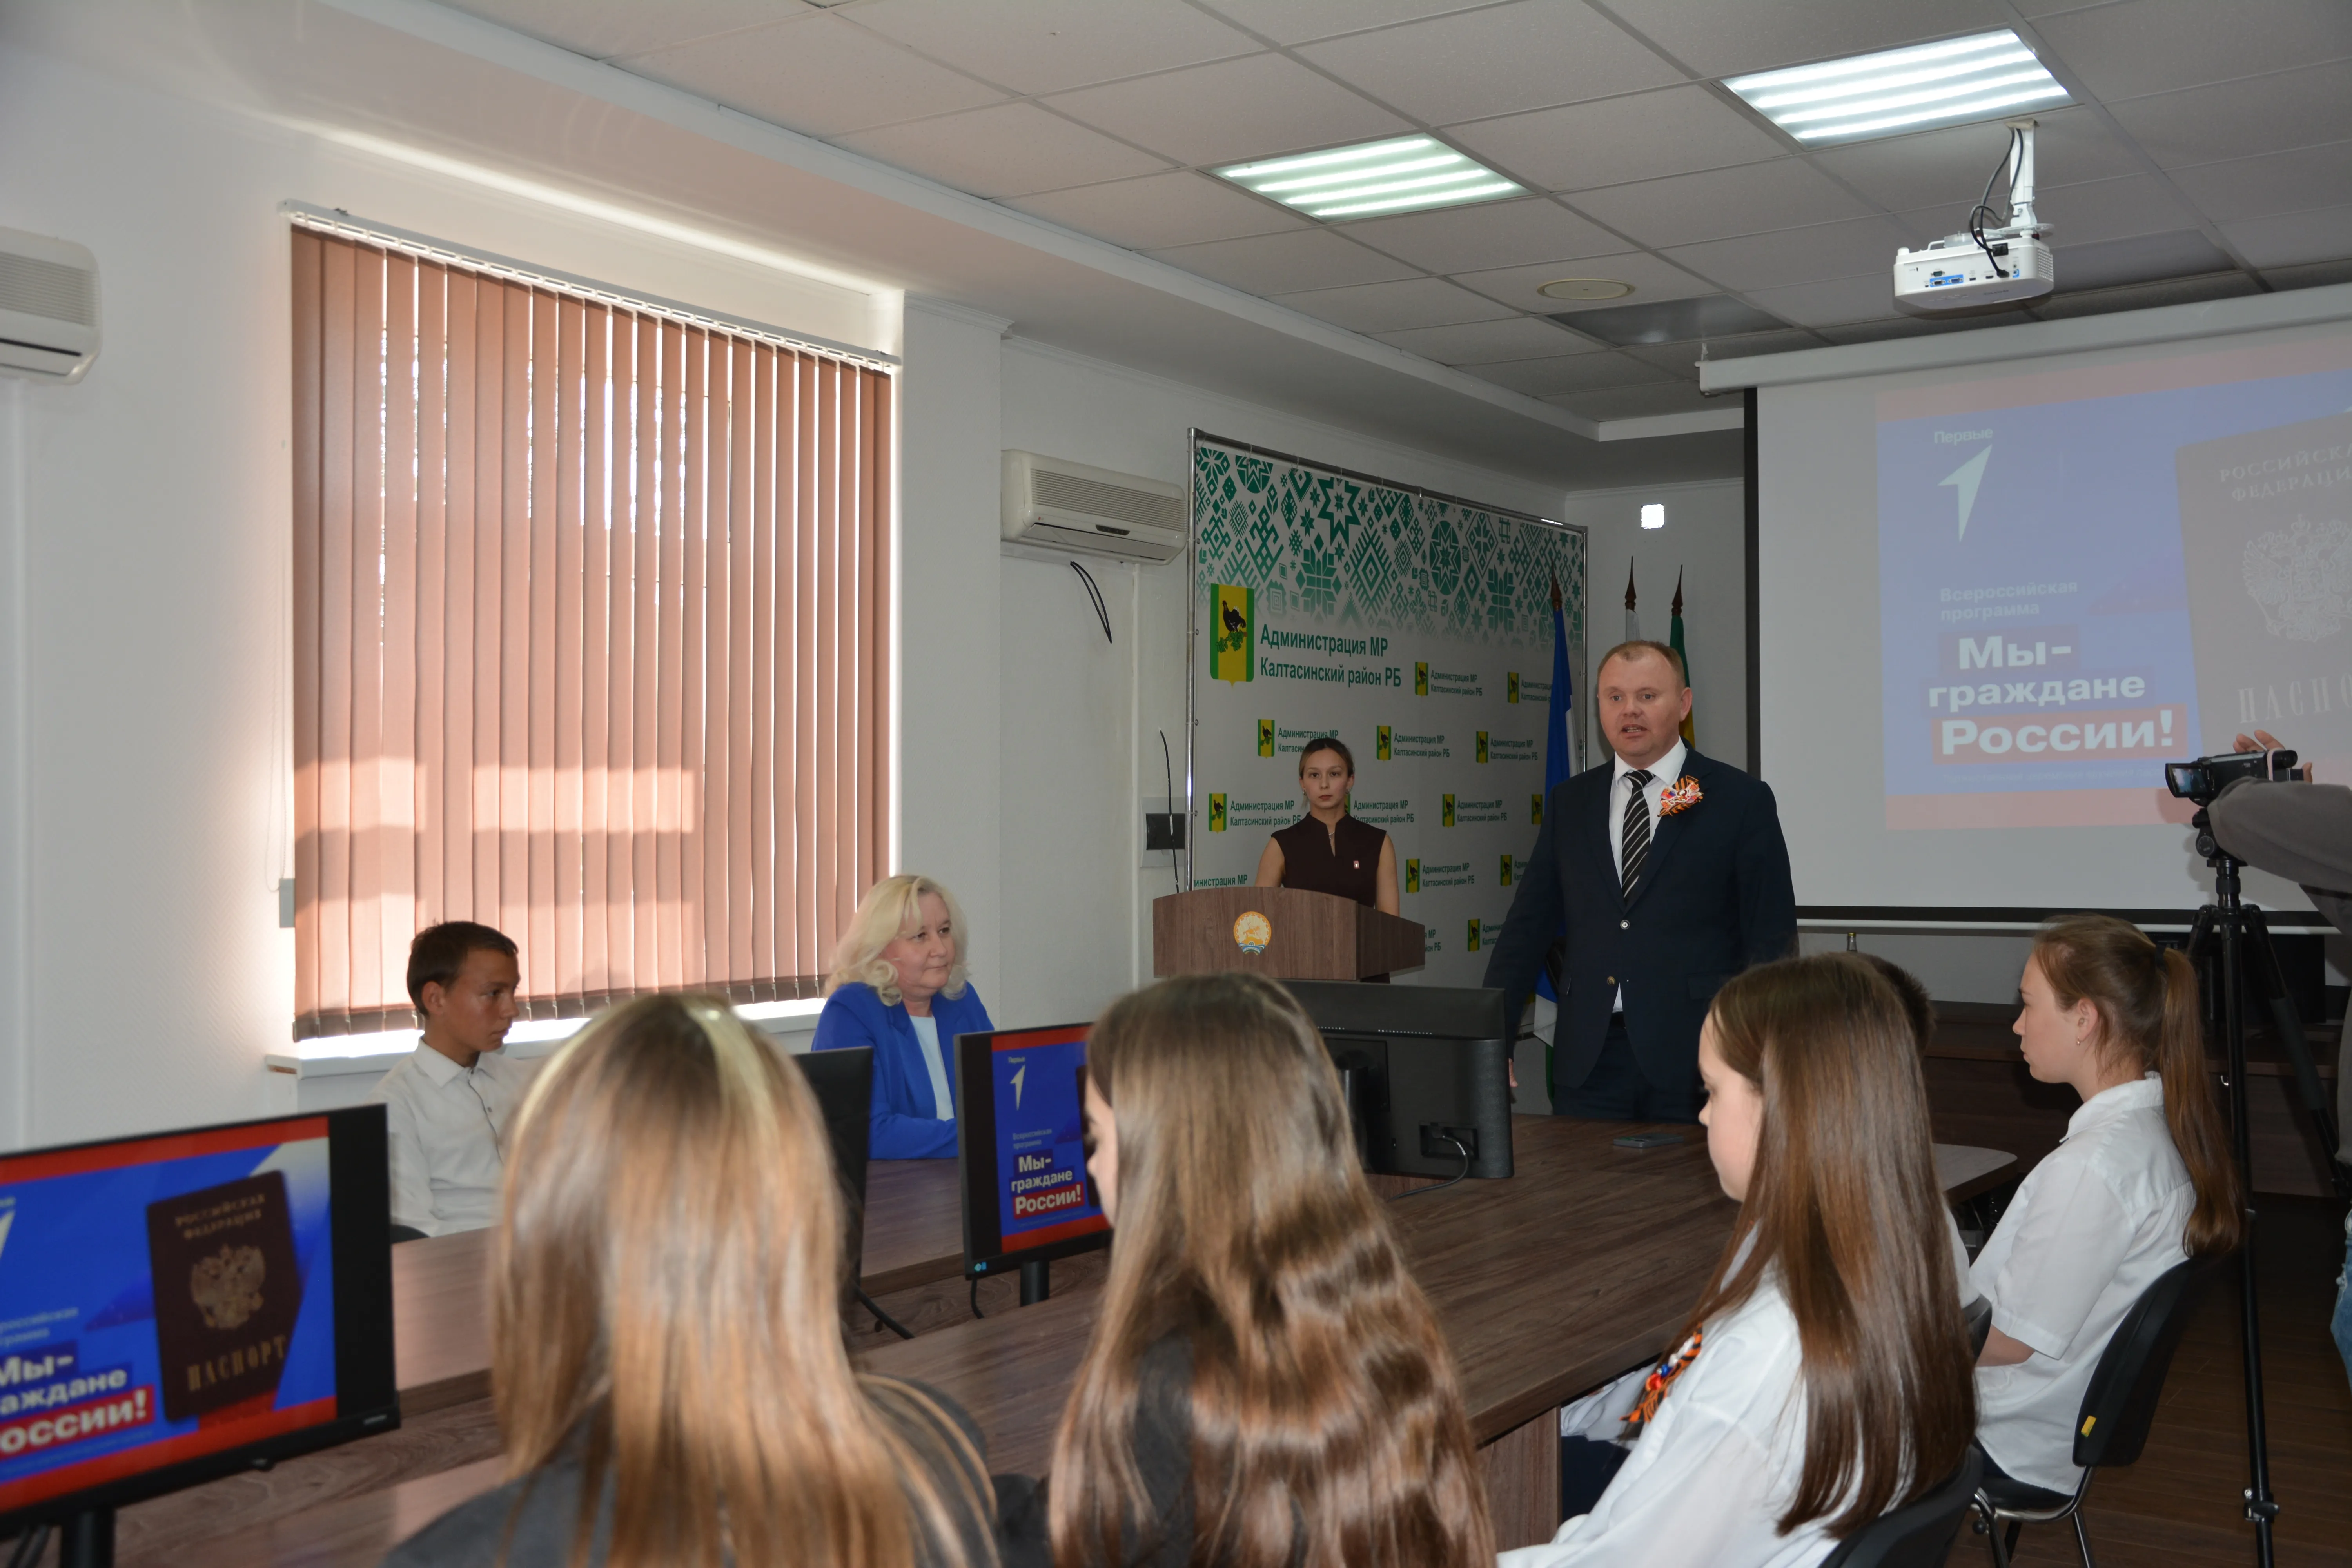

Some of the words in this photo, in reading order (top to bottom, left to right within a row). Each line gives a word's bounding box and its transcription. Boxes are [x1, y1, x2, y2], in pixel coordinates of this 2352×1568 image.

[1934, 428, 1993, 446] Первые
[1940, 581, 2078, 603] Всероссийская
[1940, 603, 2040, 624] программа
[1260, 624, 1366, 657] Администрация
[1370, 636, 1388, 657] МР
[1958, 635, 2072, 670] Мы-
[1261, 657, 1345, 683] Калтасинский
[1348, 666, 1381, 687] район
[1385, 667, 1401, 687] РБ
[1431, 670, 1469, 683] Администрация
[1470, 674, 1477, 682] МР
[1431, 684, 1461, 694] Калтасинский
[1461, 687, 1475, 697] район
[1476, 688, 1483, 696] РБ
[1928, 675, 2145, 713] граждане
[1278, 728, 1328, 740] Администрация
[1330, 730, 1339, 739] МР
[1941, 710, 2173, 755] России!
[1394, 733, 1436, 745] Администрация
[1437, 735, 1445, 744] МР
[1490, 738, 1526, 748] Администрация
[1278, 743, 1305, 753] Калтасин
[1394, 748, 1427, 757] Калтасинский
[1428, 749, 1442, 759] район
[1443, 749, 1450, 758] РБ
[1490, 751, 1518, 760] Калтасинский
[1519, 752, 1531, 761] район
[1532, 752, 1538, 760] РБ
[1230, 800, 1283, 813] Администрация
[1285, 800, 1294, 810] МР
[1354, 800, 1399, 812] Администрация
[1400, 800, 1408, 809] МР
[1457, 800, 1495, 810] Администрация
[1495, 800, 1503, 808] МР
[1230, 816, 1272, 826] Калтасинский
[1274, 816, 1291, 827] район
[1292, 815, 1301, 824] РБ
[1390, 814, 1406, 825] район
[1406, 813, 1414, 823] РБ
[1457, 813, 1486, 822] Калтасинский
[1487, 814, 1500, 824] район
[1501, 813, 1507, 821] РБ
[1422, 864, 1461, 875] Администрация
[1462, 863, 1470, 871] МР
[1238, 874, 1248, 885] МР
[1422, 878, 1452, 887] Калтасинский
[1454, 877, 1466, 887] район
[1468, 875, 1475, 884] РБ
[1428, 929, 1436, 938] МР
[1434, 942, 1441, 951] РБ
[1018, 1154, 1052, 1172] Мы-
[1011, 1170, 1073, 1194] граждане
[1015, 1184, 1081, 1214] России!
[0, 1368, 127, 1416] аждане
[0, 1388, 147, 1454] оссии!
